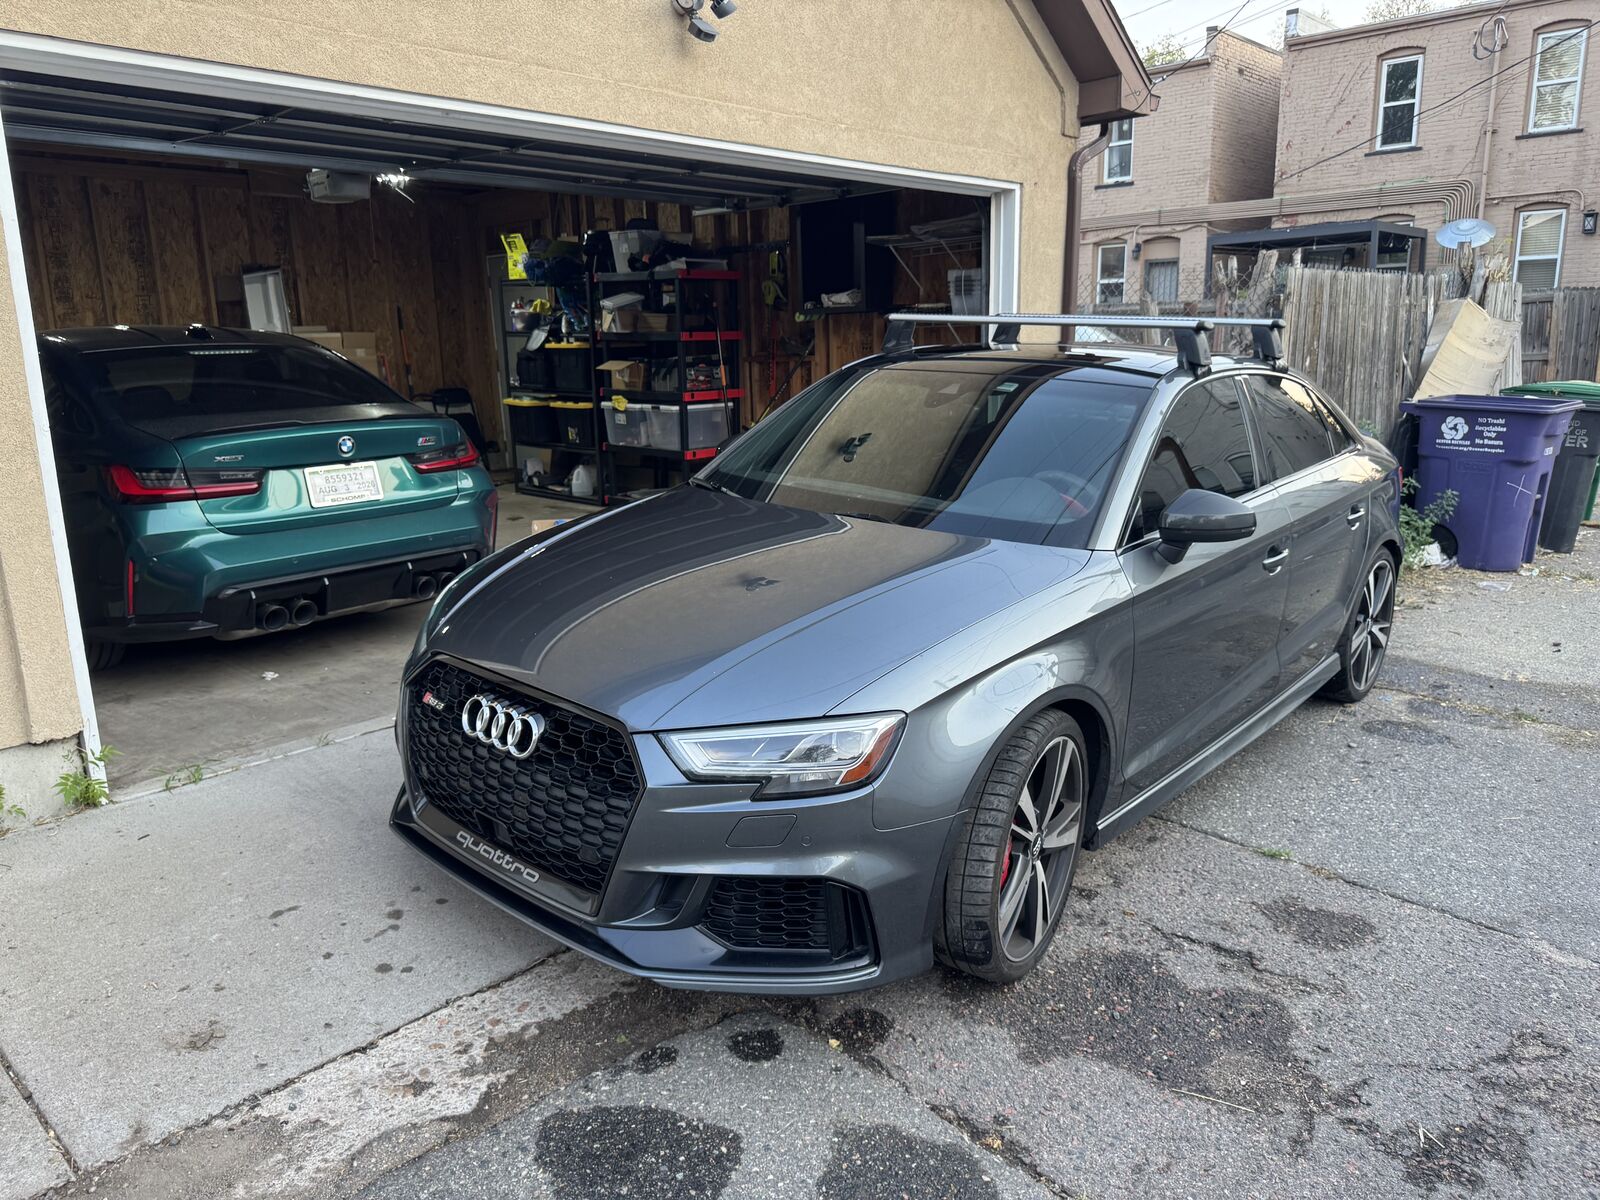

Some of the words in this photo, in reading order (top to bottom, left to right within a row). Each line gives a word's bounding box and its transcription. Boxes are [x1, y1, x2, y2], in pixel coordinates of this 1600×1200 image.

[1564, 434, 1588, 448] ER
[319, 486, 338, 494] AUG
[456, 830, 540, 883] quattro
